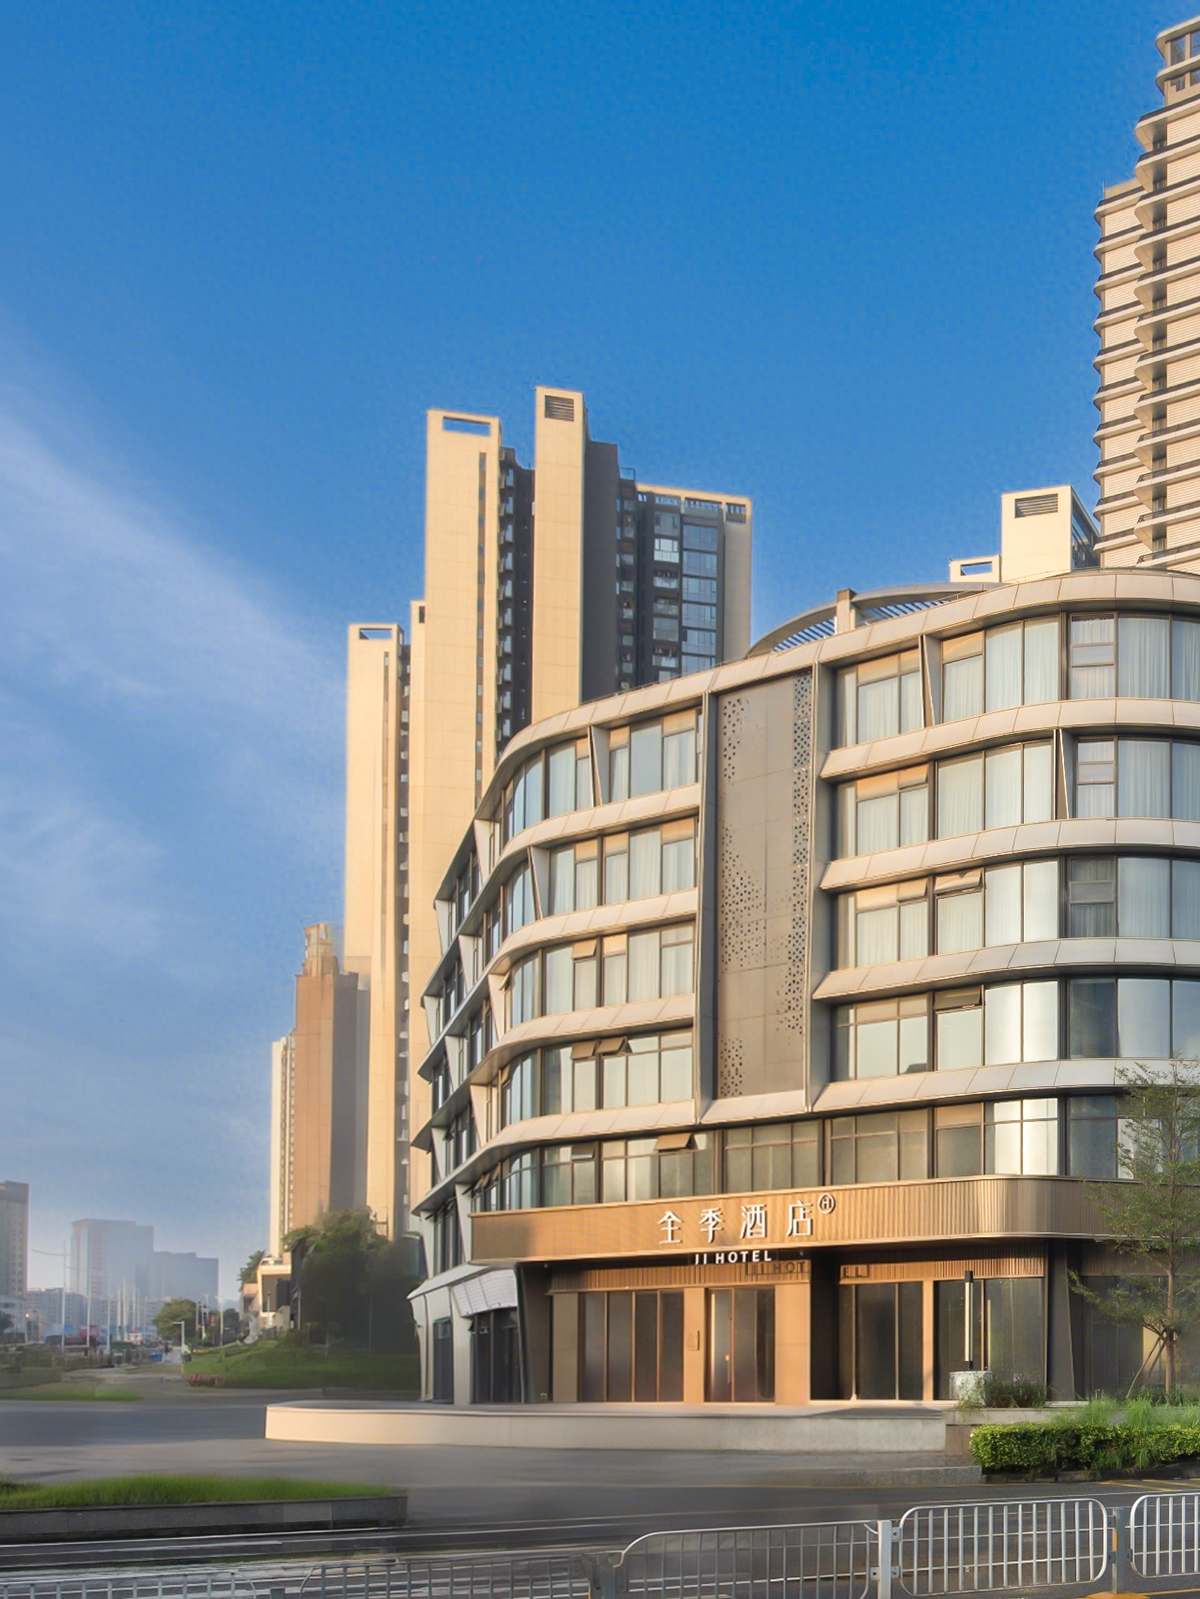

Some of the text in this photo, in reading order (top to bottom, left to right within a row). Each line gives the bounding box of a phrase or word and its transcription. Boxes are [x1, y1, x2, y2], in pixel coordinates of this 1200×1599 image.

[657, 1200, 814, 1244] 全季酒店
[694, 1250, 772, 1266] JI HOTEL
